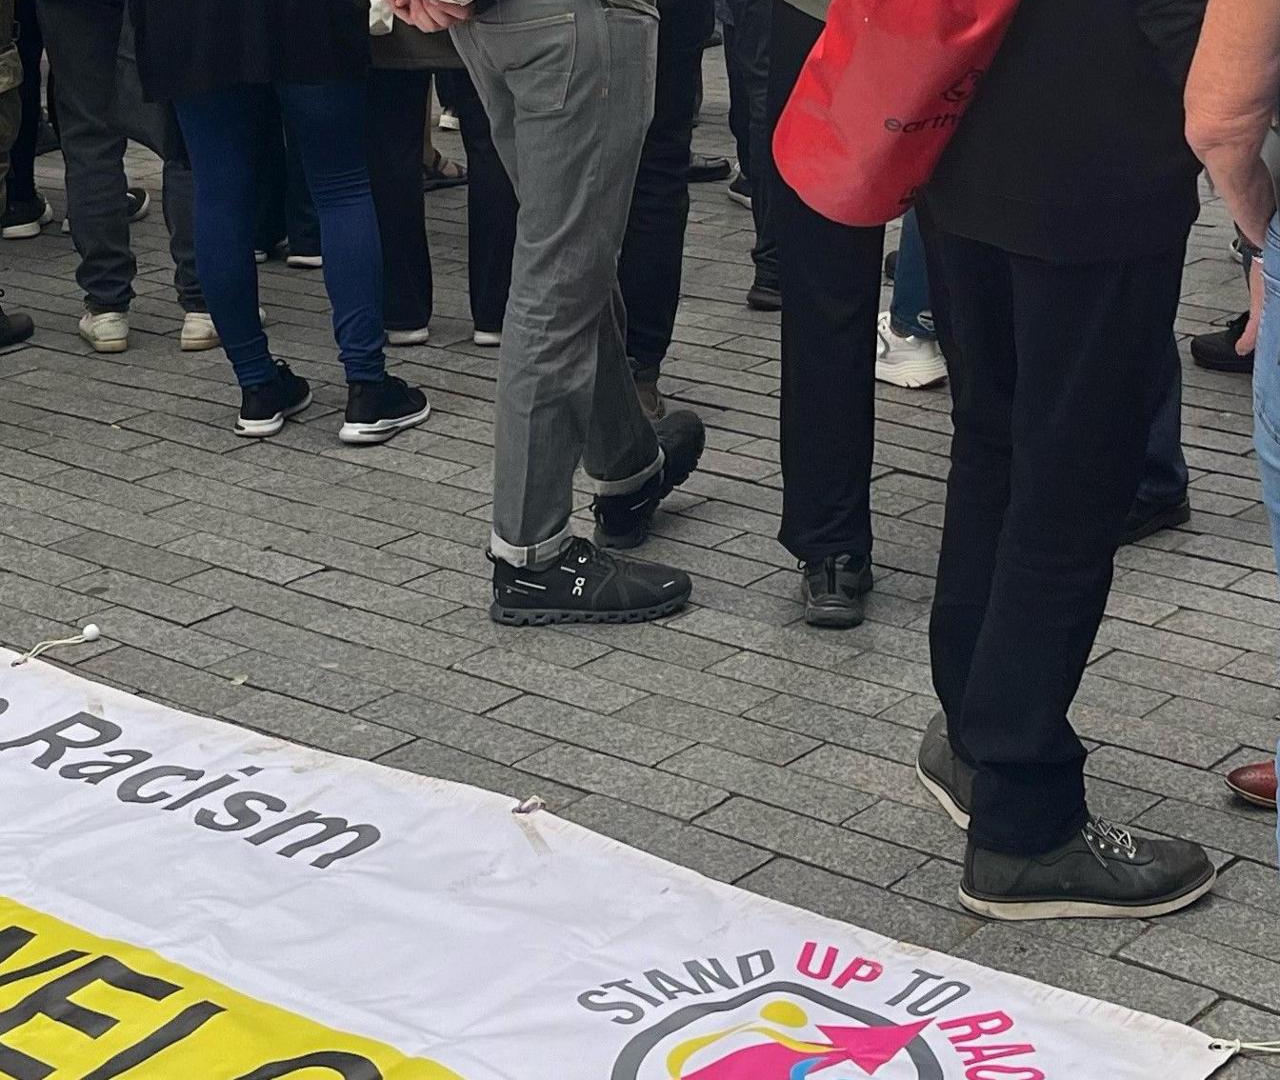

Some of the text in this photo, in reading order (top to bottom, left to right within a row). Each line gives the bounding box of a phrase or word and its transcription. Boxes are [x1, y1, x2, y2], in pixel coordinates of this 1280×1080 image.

[577, 948, 775, 1025] STAND
[796, 940, 884, 989] UP
[884, 968, 971, 1017] TO
